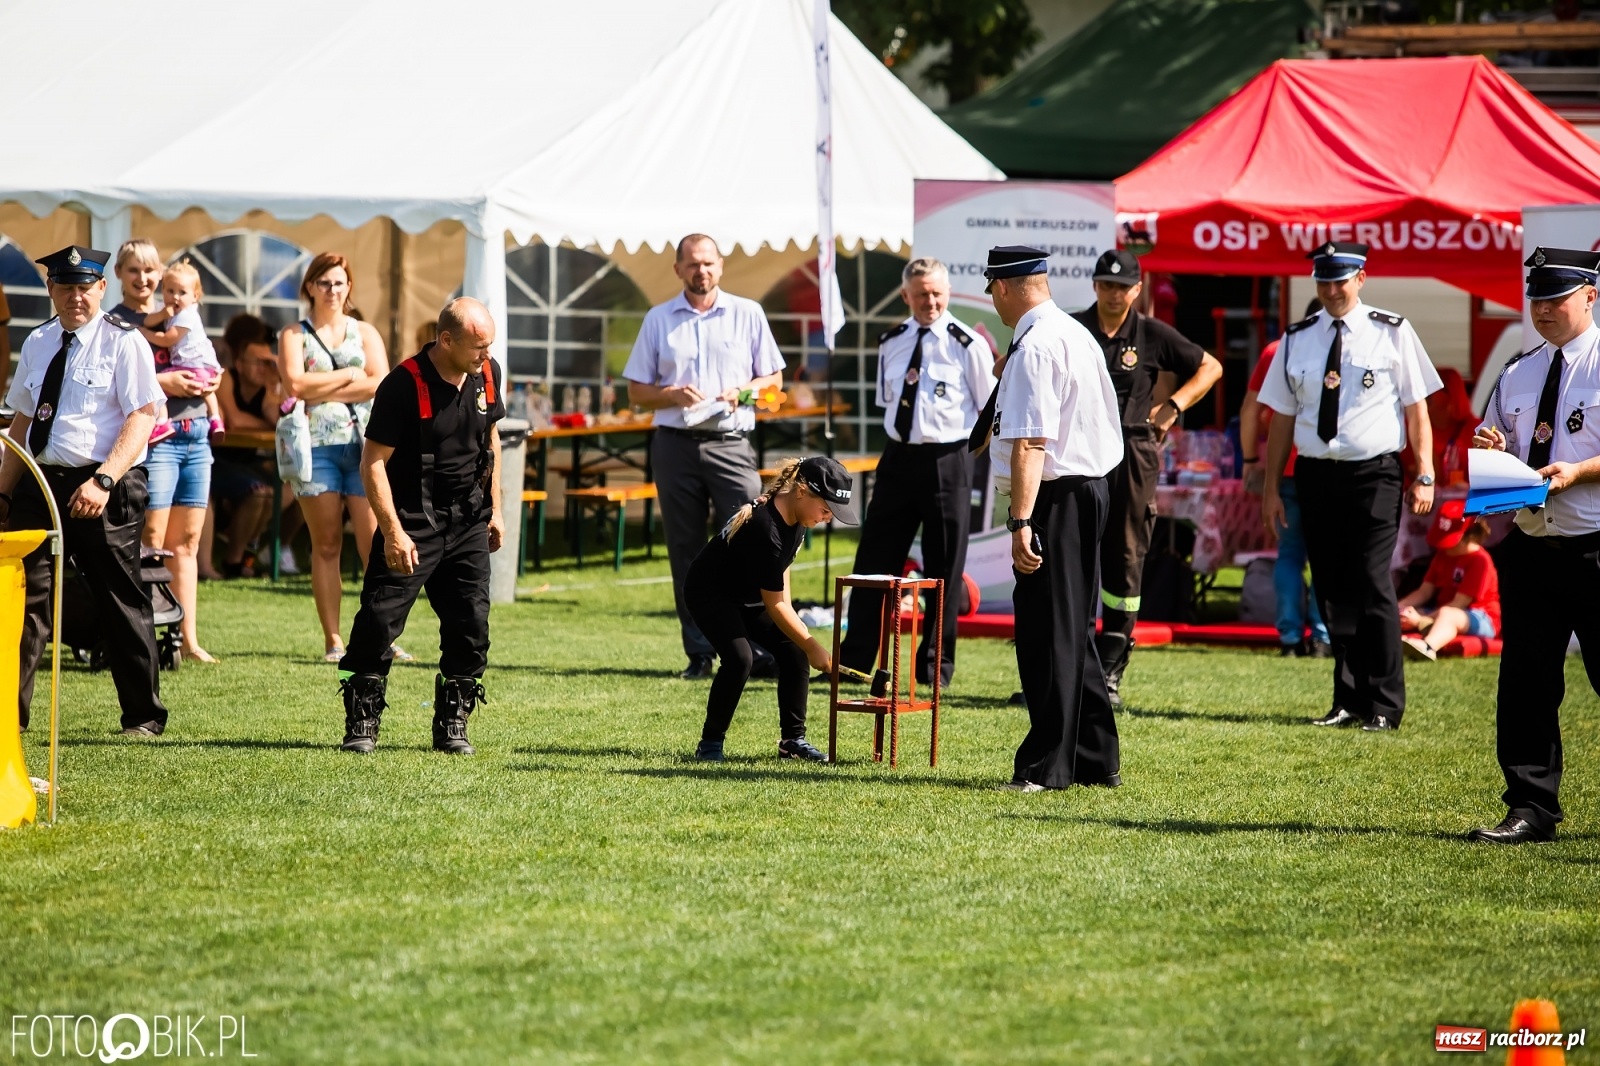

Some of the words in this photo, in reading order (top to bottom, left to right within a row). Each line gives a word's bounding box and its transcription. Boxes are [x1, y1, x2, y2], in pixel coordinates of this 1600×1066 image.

[966, 217, 1010, 229] GMINA
[1016, 218, 1099, 231] WIERUSZÓW
[1193, 220, 1270, 251] OSP
